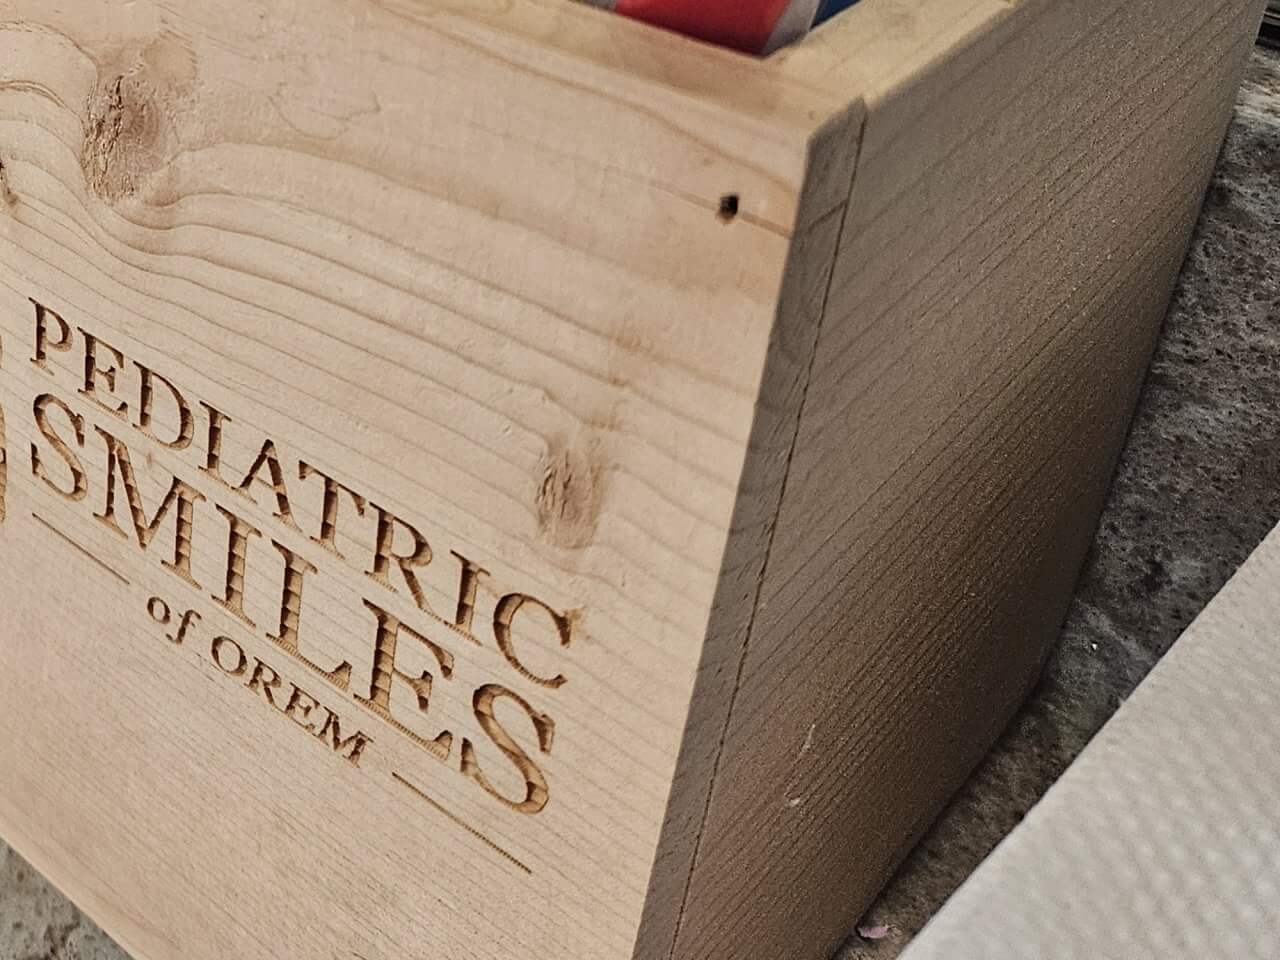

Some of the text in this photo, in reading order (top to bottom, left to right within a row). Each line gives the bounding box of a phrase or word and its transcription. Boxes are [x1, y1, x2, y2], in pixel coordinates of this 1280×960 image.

[29, 296, 574, 691] PEDIATRIC
[31, 392, 556, 814] SMILES
[146, 596, 376, 768] of OREM
